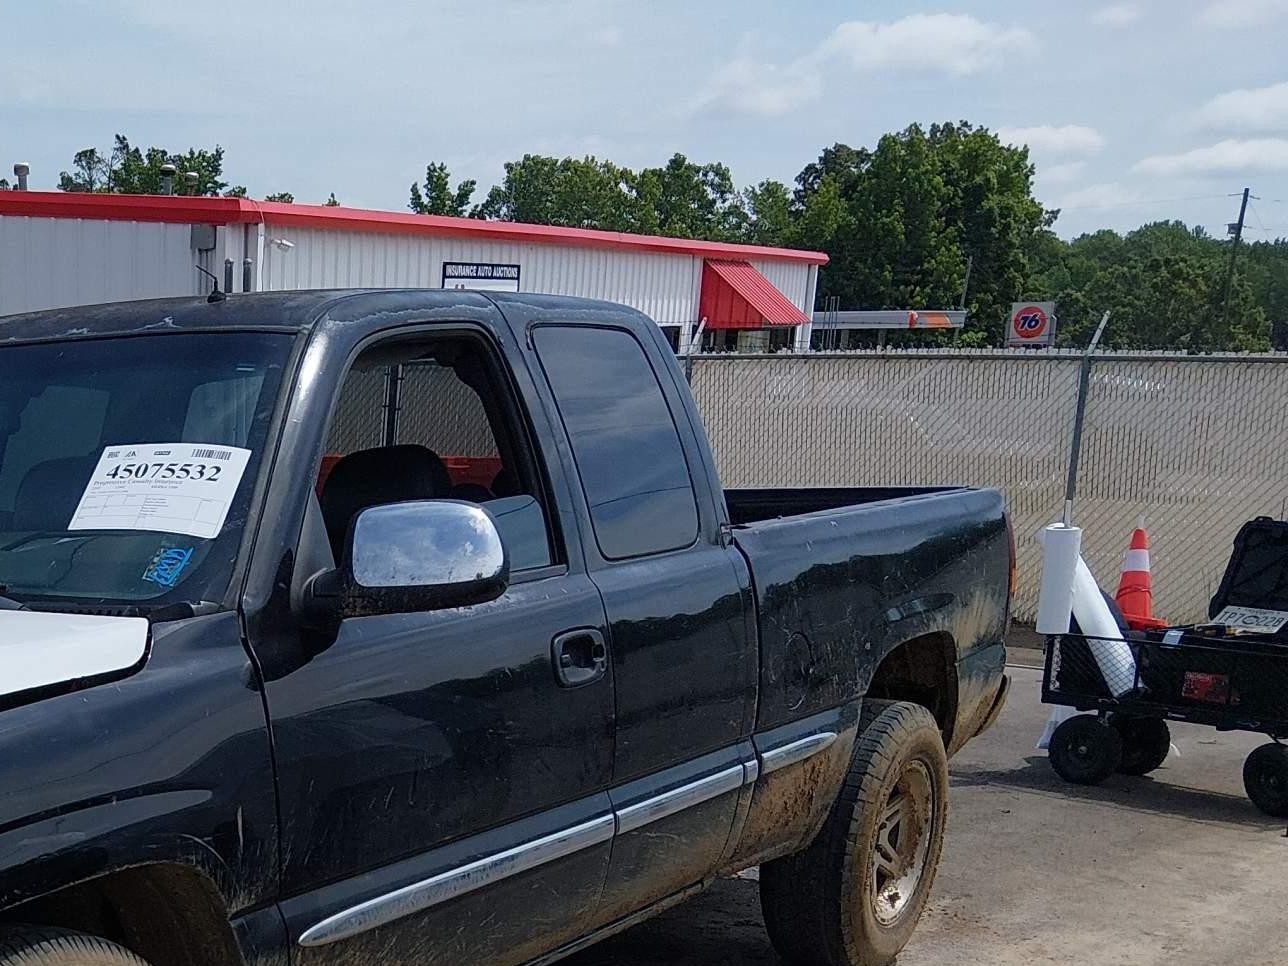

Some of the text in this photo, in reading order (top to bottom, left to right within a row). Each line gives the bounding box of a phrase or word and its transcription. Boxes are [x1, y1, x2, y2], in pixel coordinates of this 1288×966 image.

[445, 264, 518, 278] INSURANCE AUTO AUCTIONS
[1018, 313, 1041, 330] 76
[105, 462, 222, 482] 45075532
